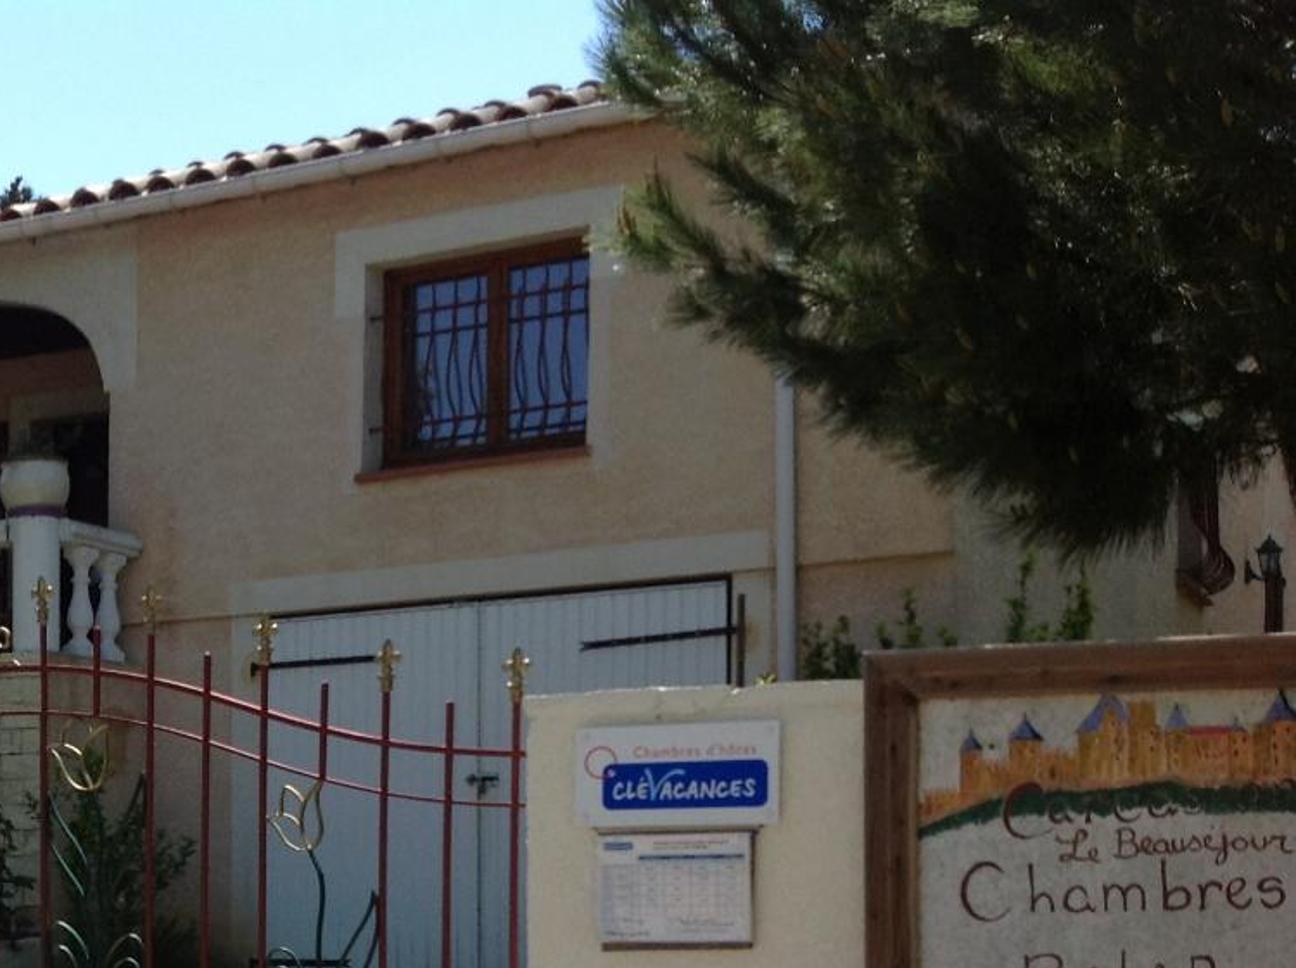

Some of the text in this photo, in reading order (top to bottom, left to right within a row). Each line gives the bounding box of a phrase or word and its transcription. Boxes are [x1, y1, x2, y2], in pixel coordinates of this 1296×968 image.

[611, 767, 757, 801] CLÉVACANCES
[1054, 828, 1099, 863] Le
[959, 859, 1288, 922] Chambres
